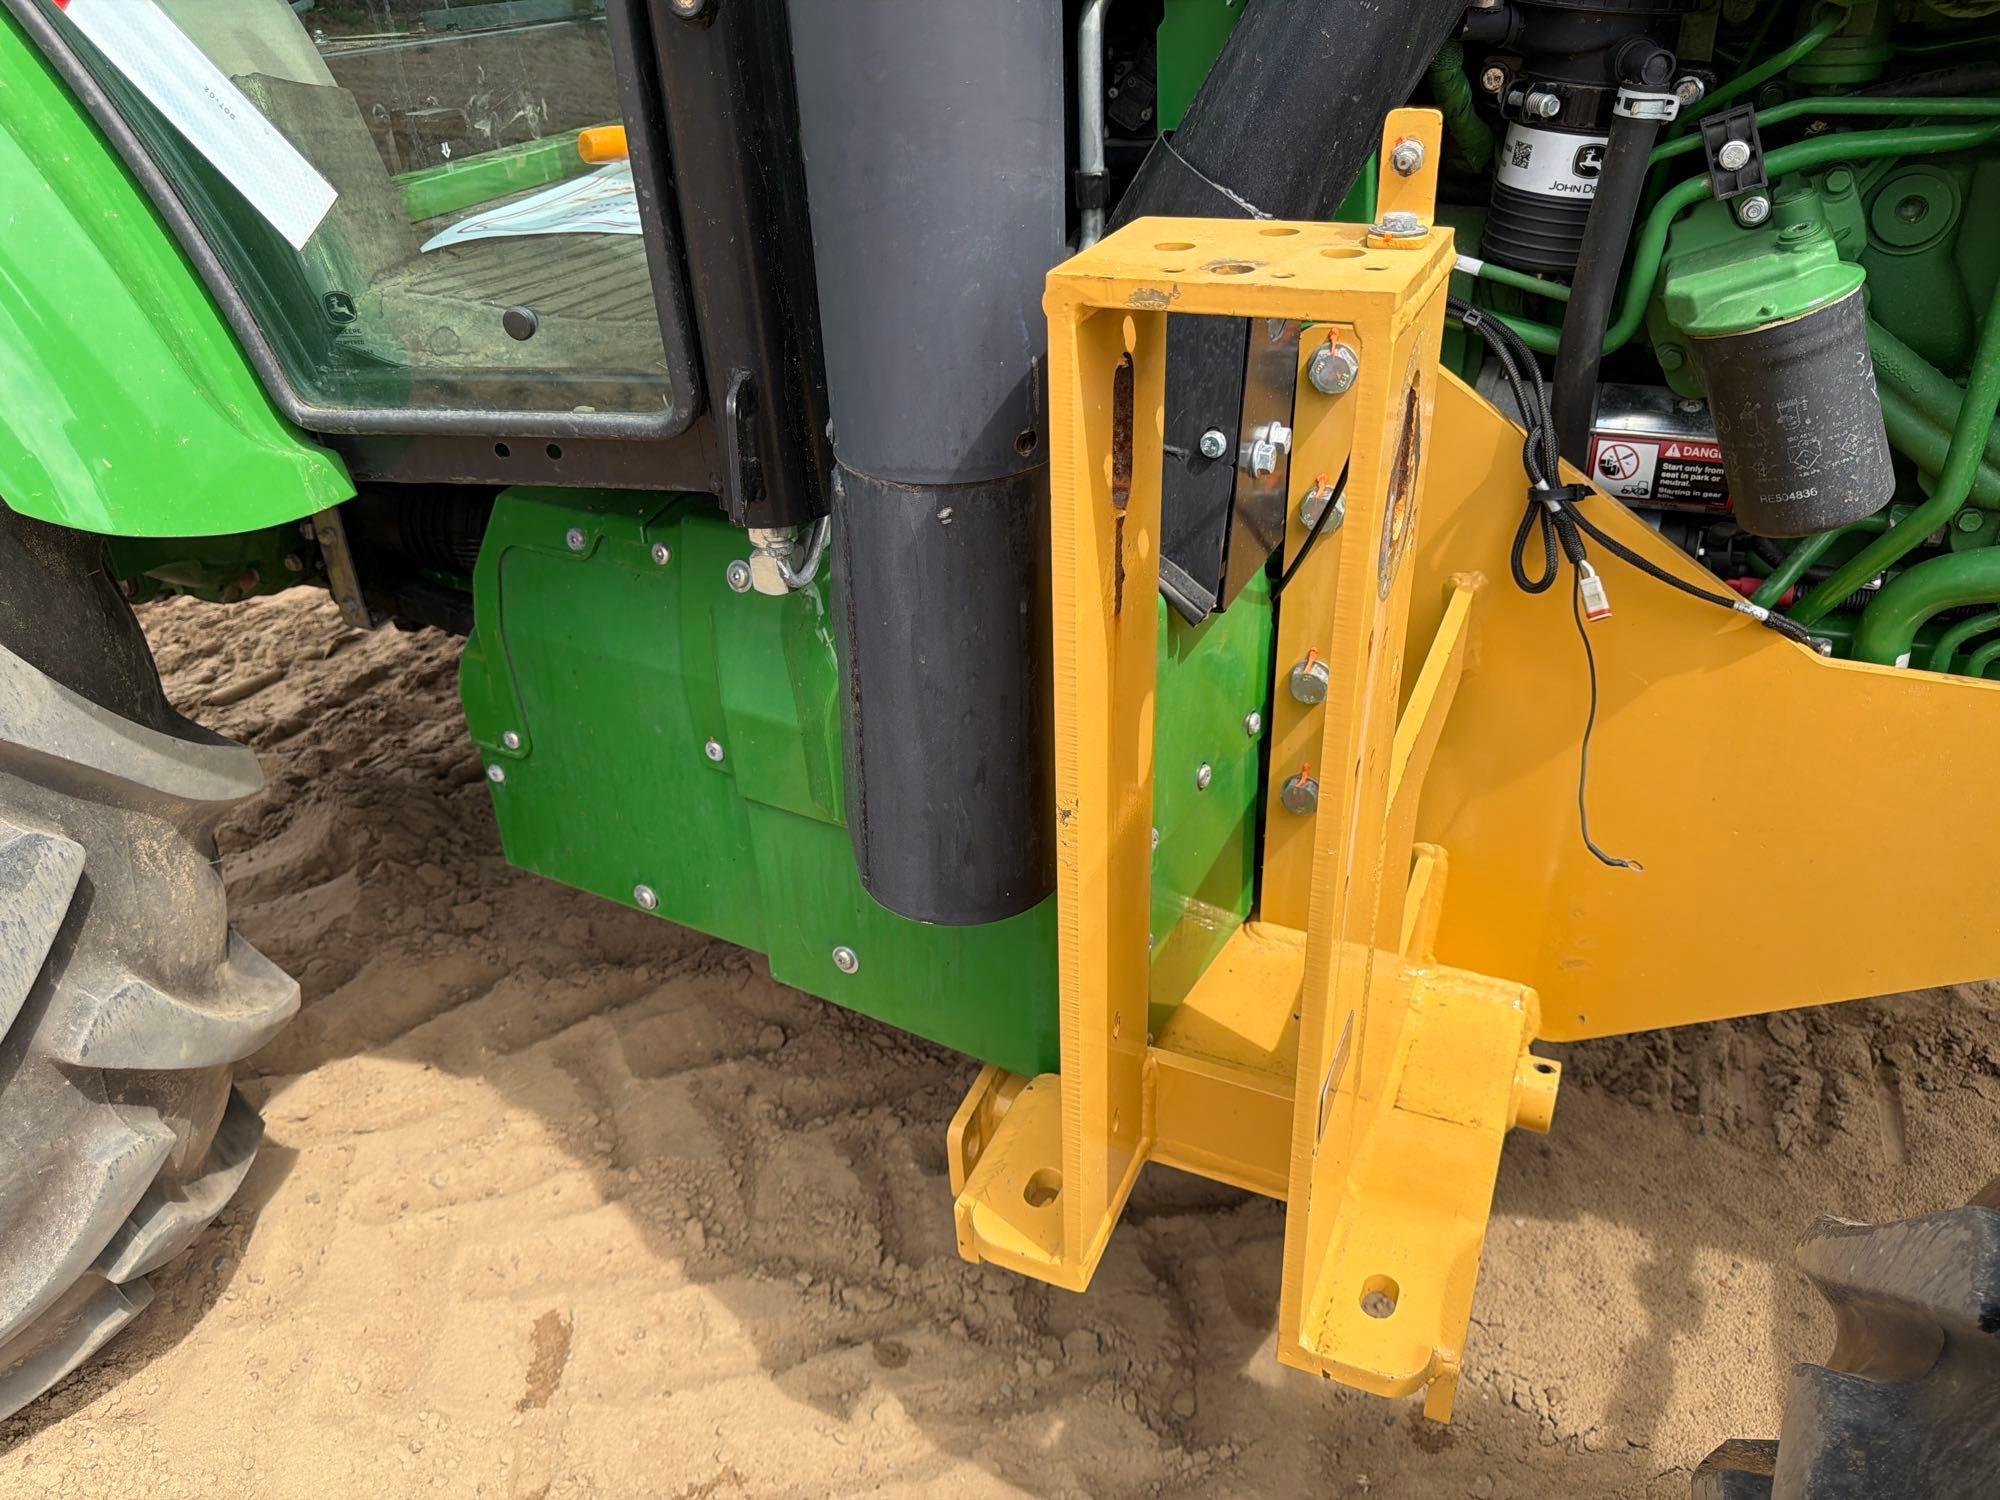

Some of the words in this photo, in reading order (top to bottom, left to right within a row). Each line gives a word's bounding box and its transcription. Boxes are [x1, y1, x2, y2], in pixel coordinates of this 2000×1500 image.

[1548, 180, 1581, 193] JOHN
[1683, 446, 1722, 459] DANG
[1662, 462, 1683, 472] Start
[1684, 465, 1703, 475] only
[1705, 466, 1725, 475] from
[1659, 479, 1691, 487] neutral.
[1661, 472, 1679, 480] seat
[1690, 474, 1709, 483] park
[1658, 486, 1692, 497] Starting
[1702, 491, 1722, 499] gear
[1759, 487, 1818, 504] RE504836
